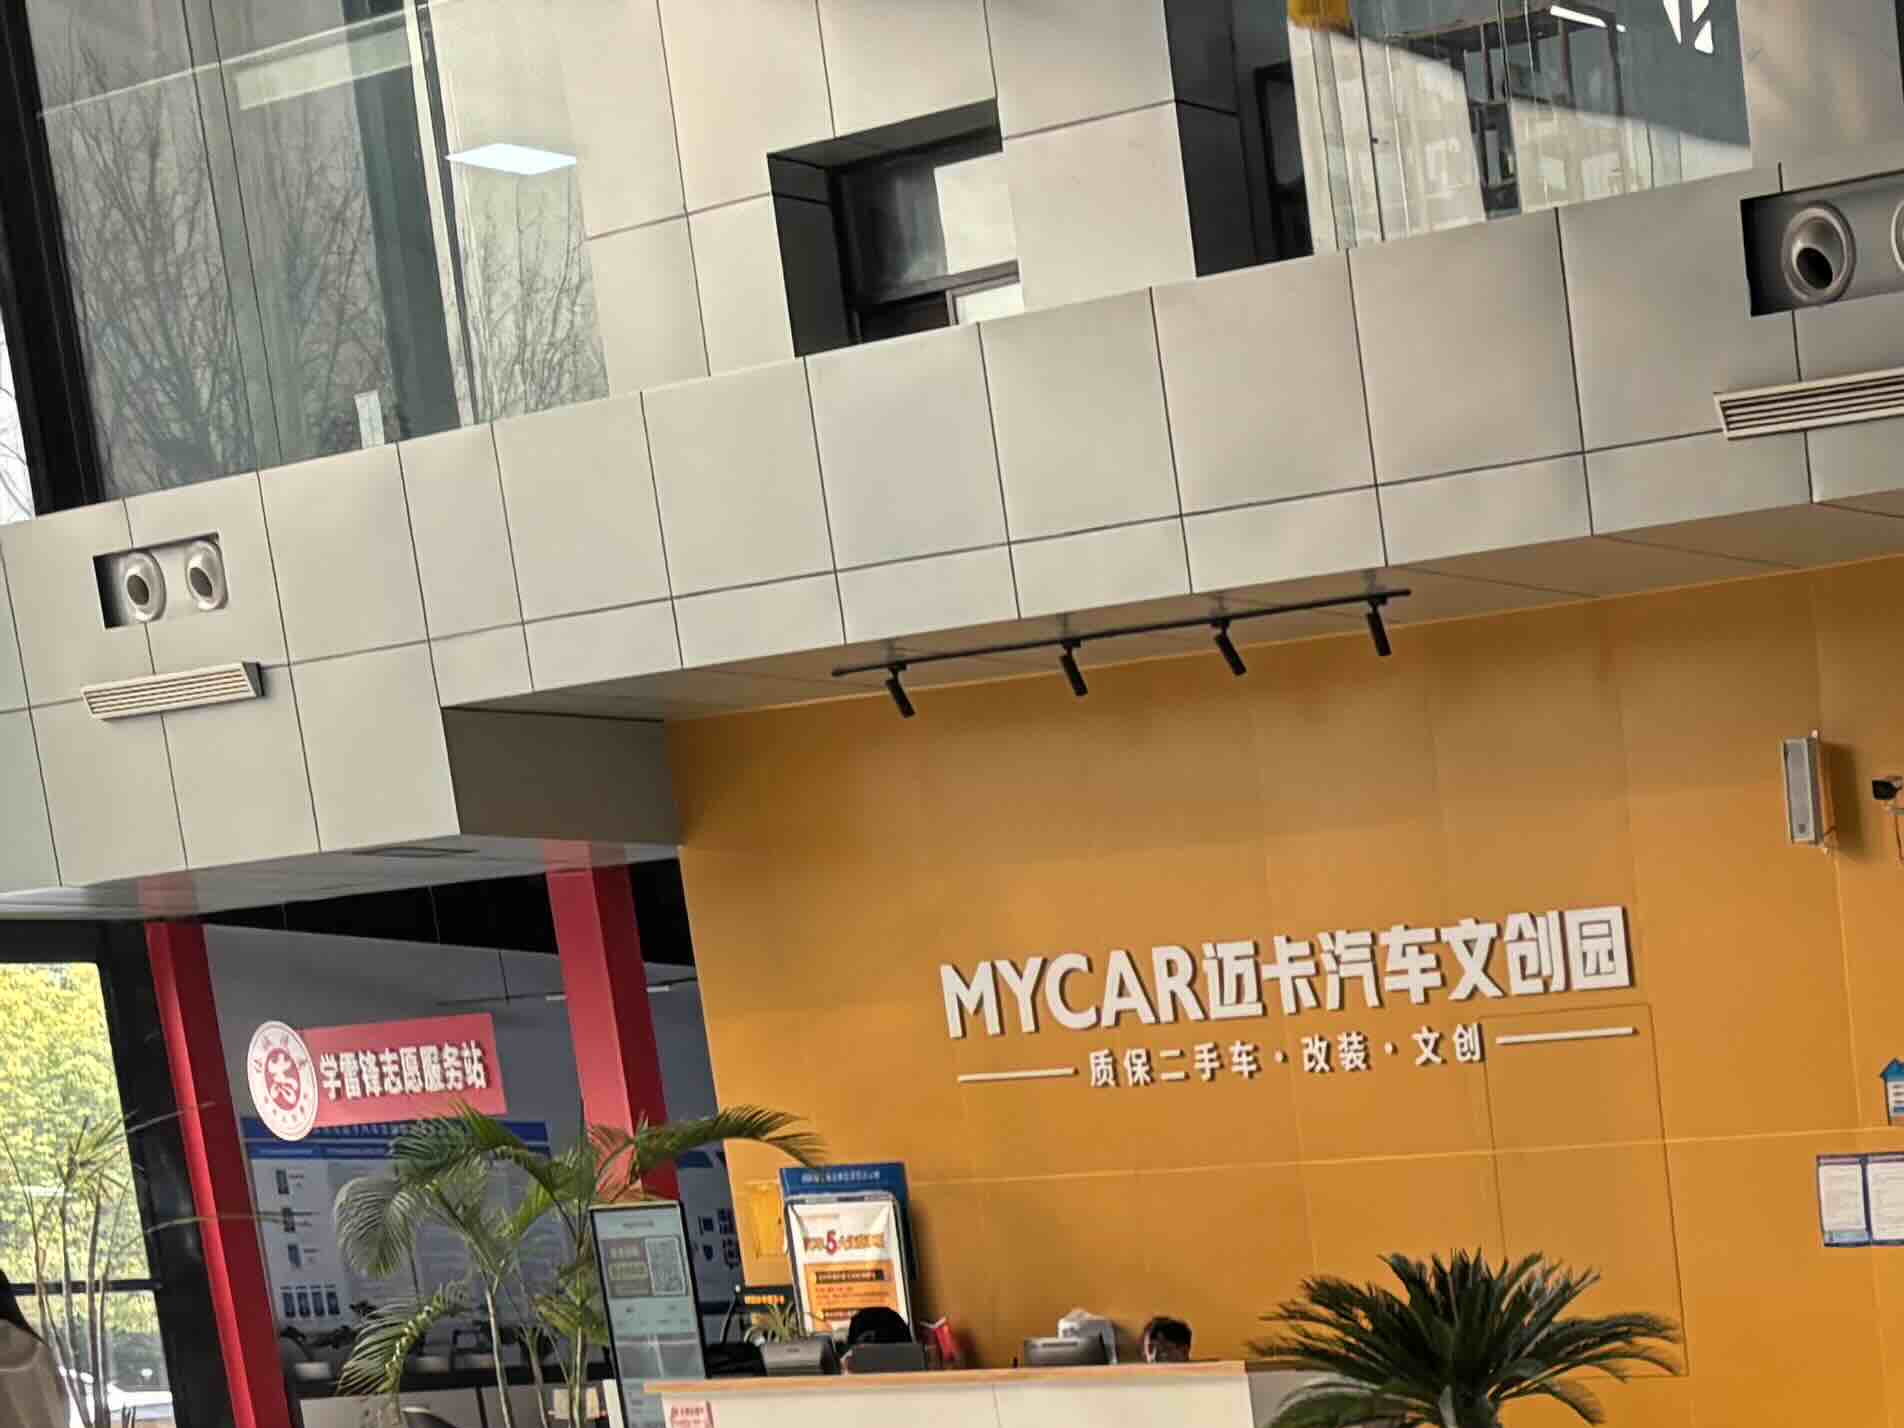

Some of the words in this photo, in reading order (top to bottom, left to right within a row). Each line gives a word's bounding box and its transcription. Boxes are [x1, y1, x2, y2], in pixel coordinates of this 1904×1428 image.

[939, 905, 1632, 1040] MYCAR迈卡汽车文创园
[319, 1040, 487, 1102] 学雷锋志愿服务站
